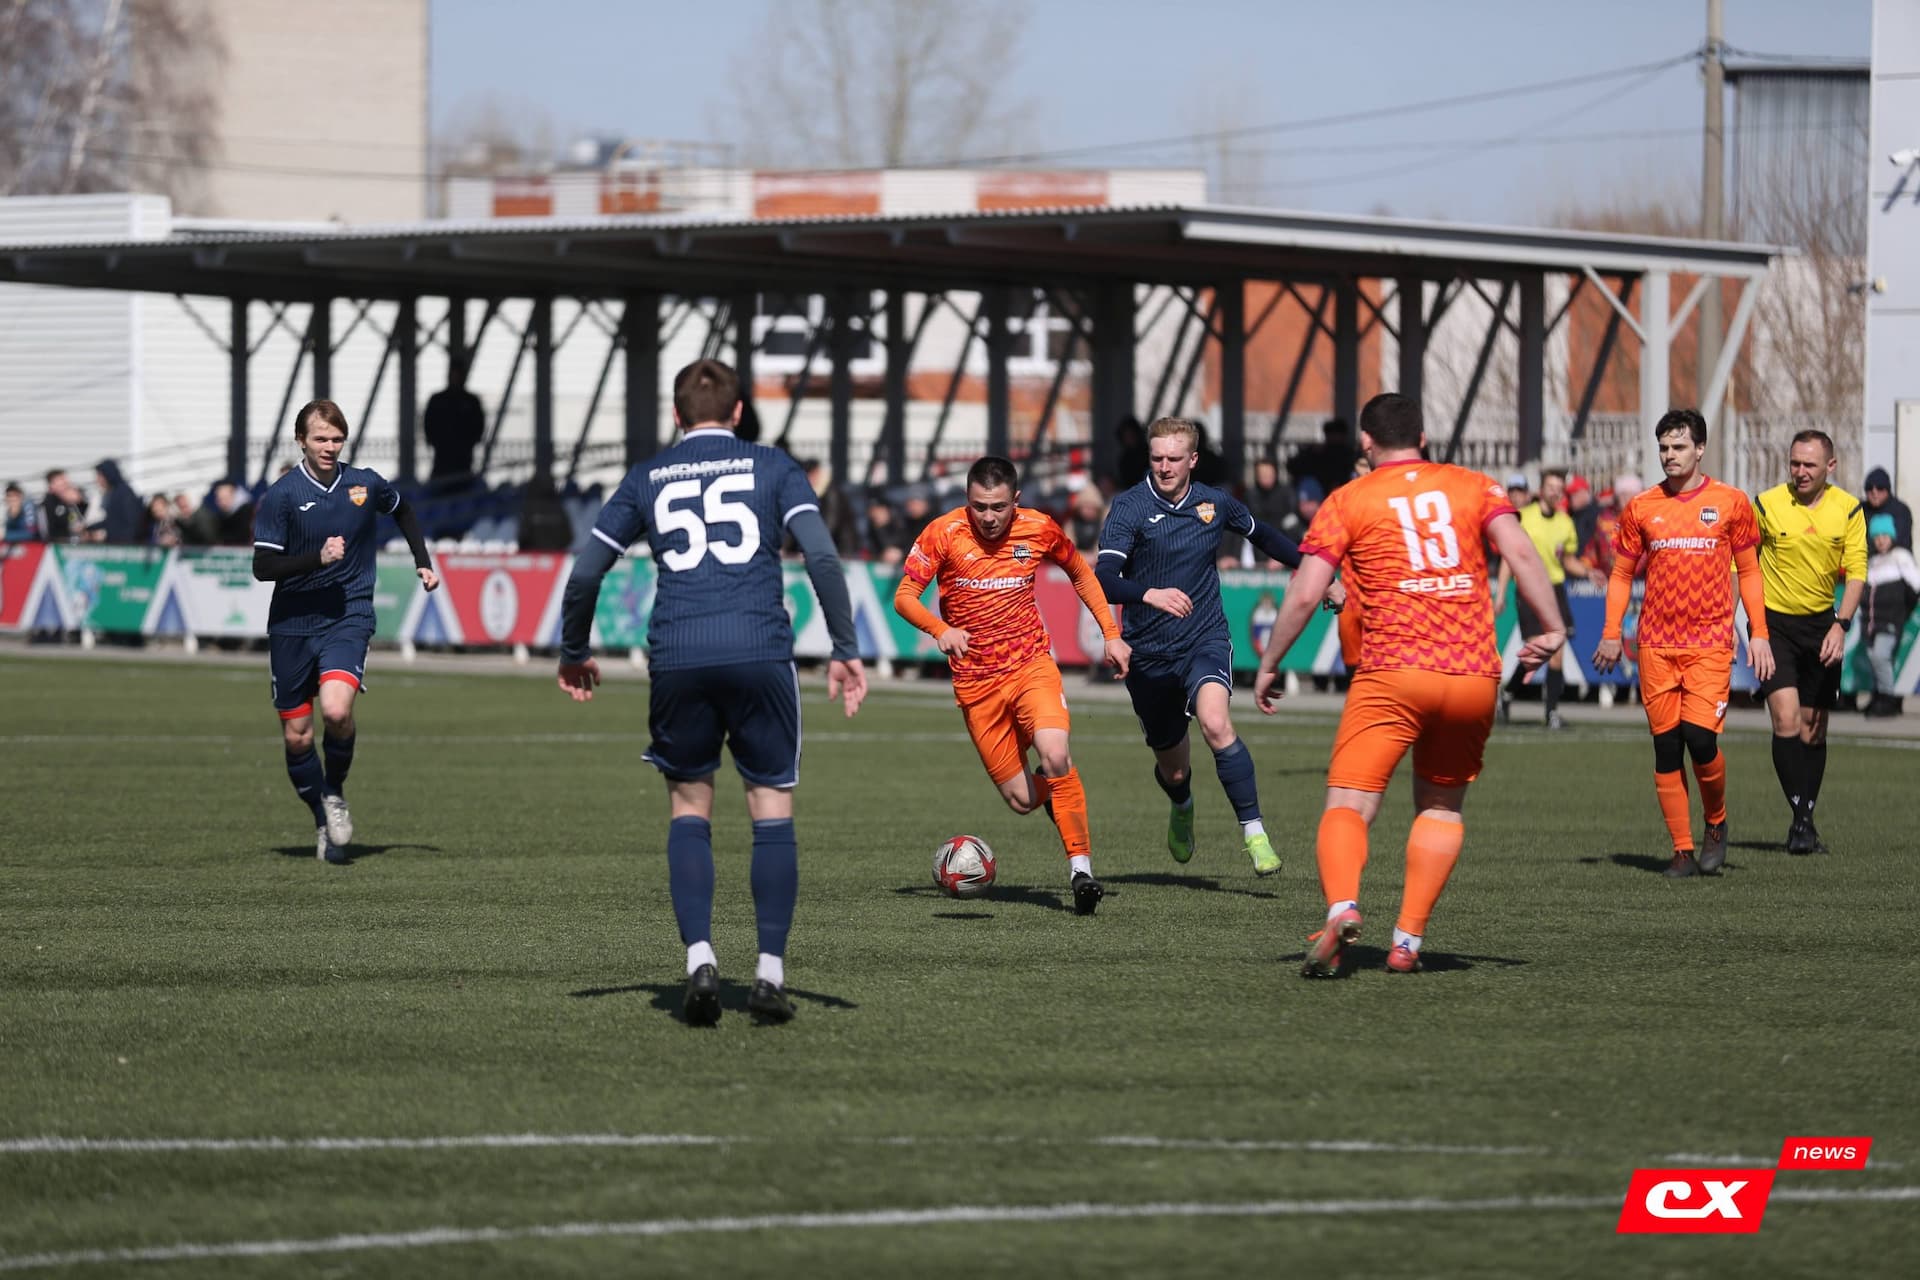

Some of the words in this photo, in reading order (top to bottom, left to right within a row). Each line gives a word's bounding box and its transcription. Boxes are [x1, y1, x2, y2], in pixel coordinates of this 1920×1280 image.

[654, 473, 760, 572] 55
[1388, 490, 1460, 571] 13
[1399, 574, 1473, 592] SEUS
